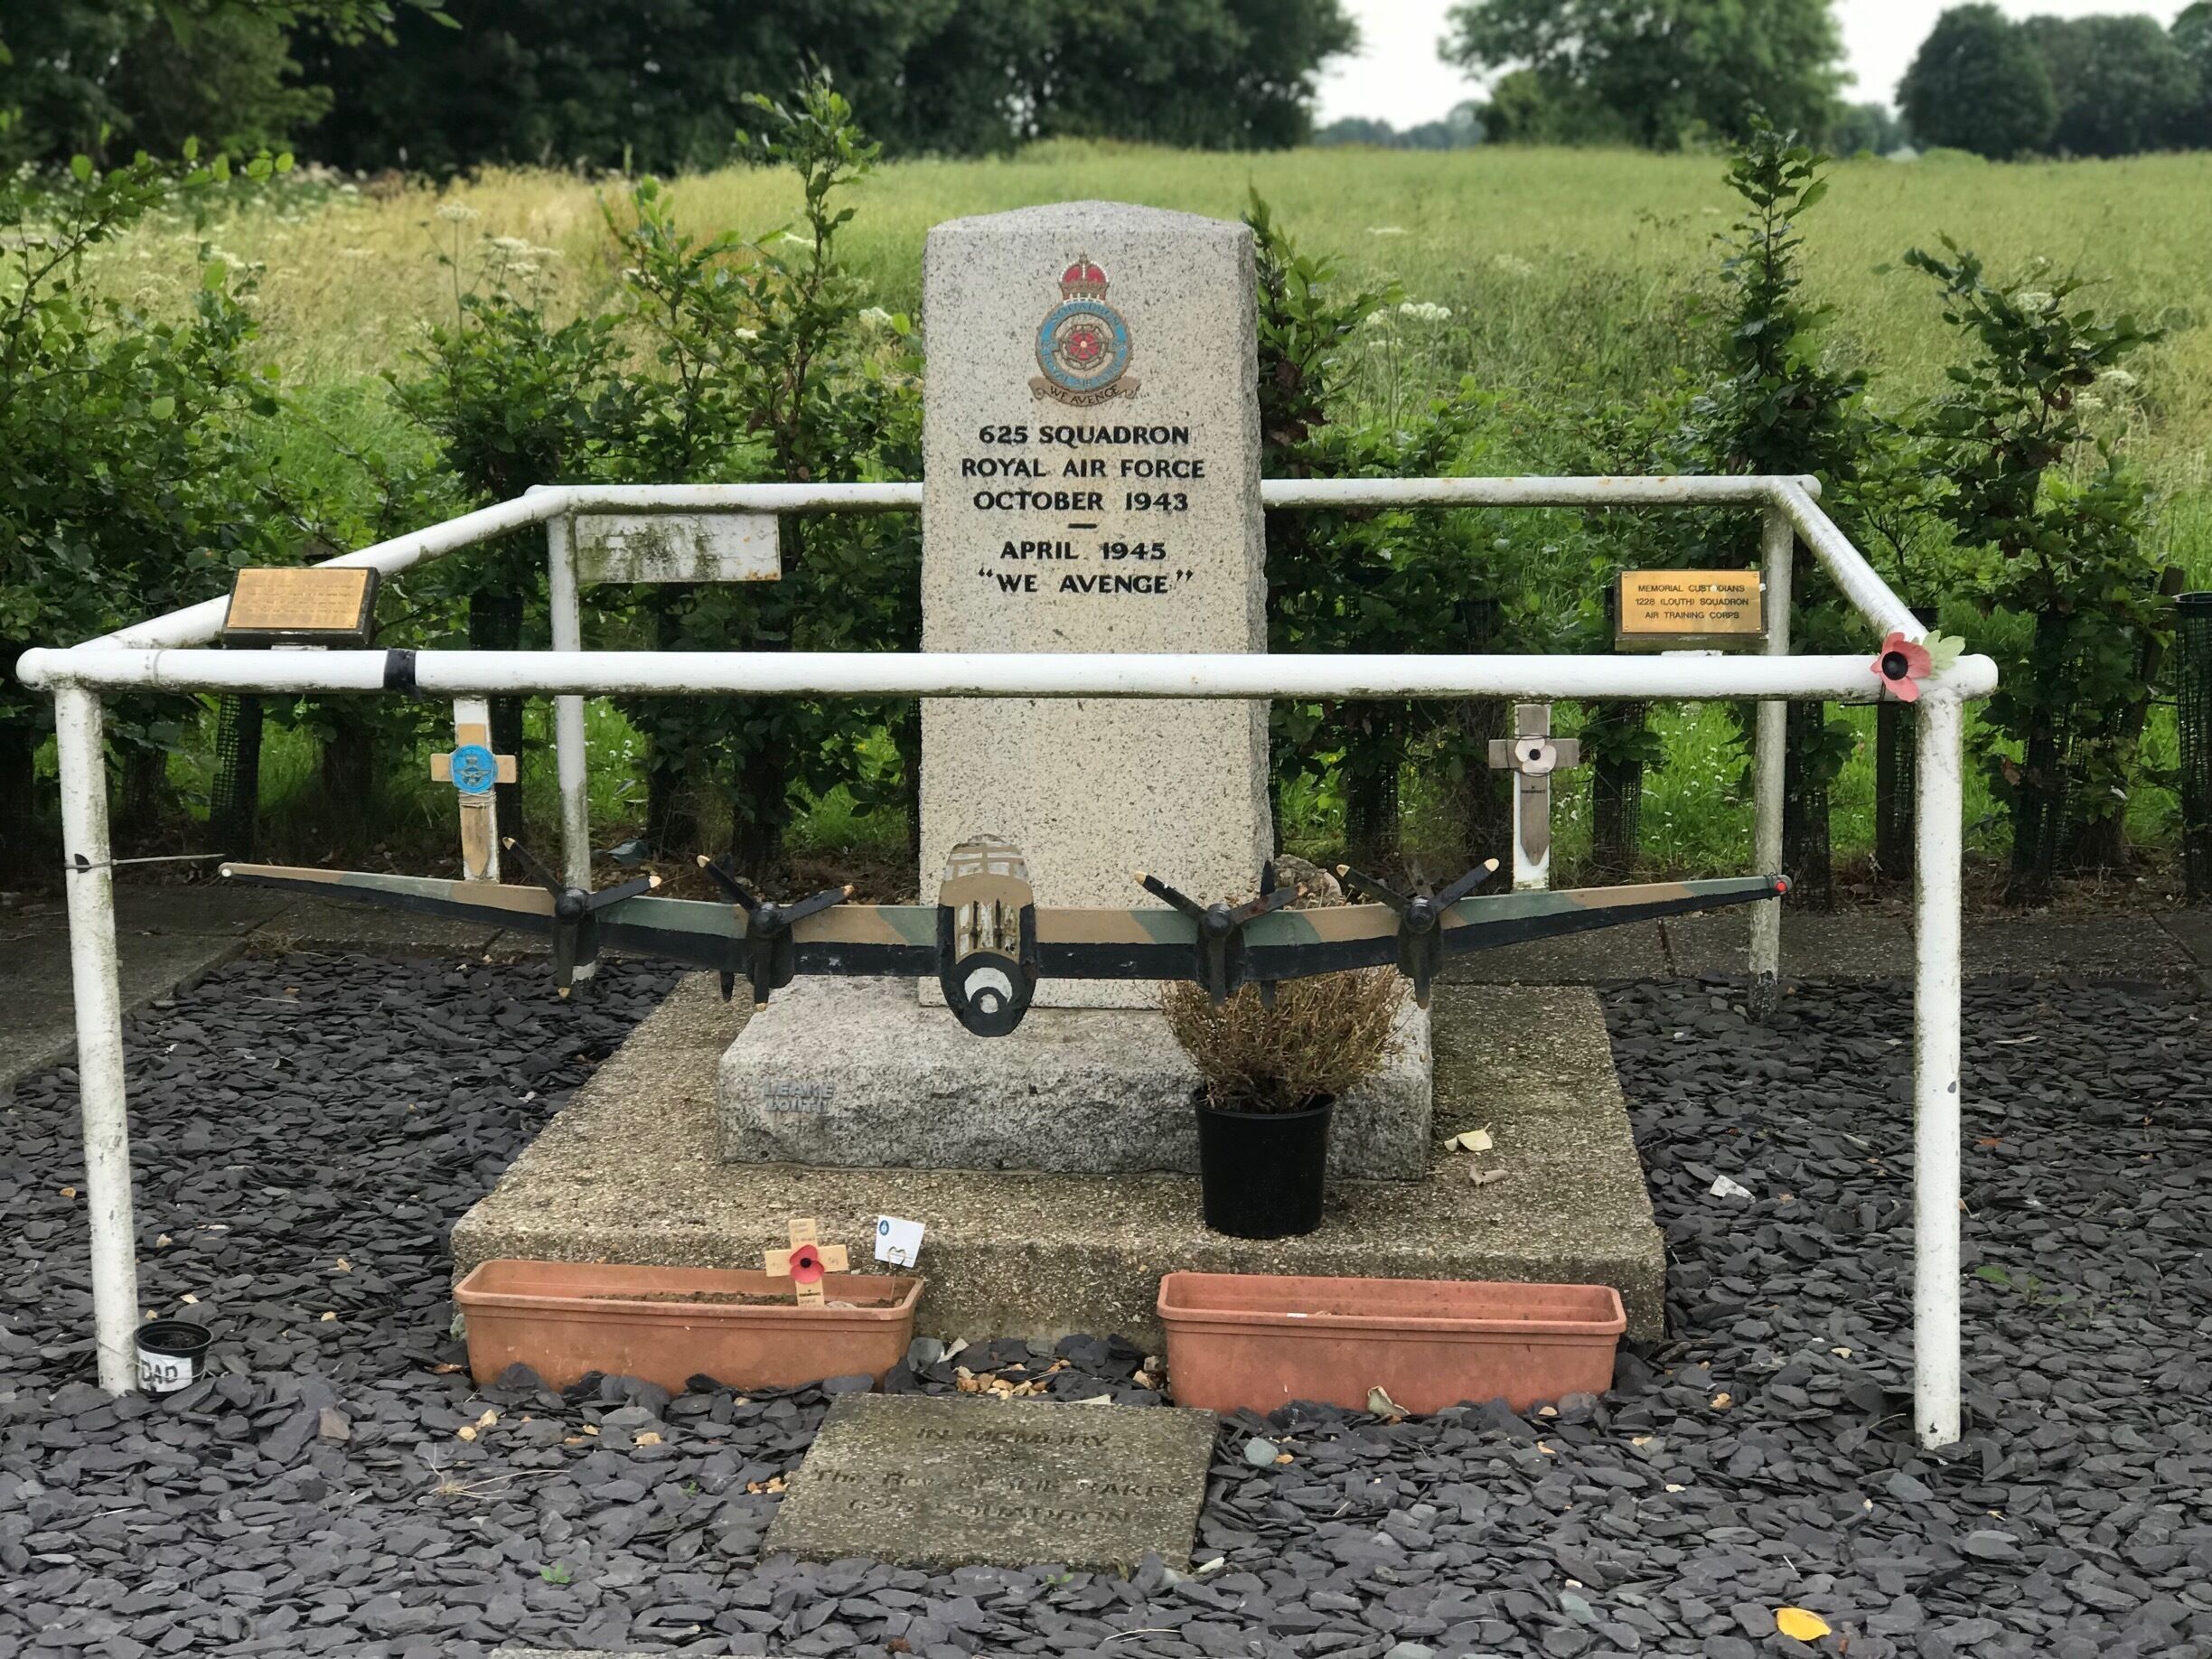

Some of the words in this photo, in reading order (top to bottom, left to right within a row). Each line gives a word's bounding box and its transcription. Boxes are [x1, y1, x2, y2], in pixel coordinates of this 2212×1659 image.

[1049, 385, 1067, 400] WE
[1070, 383, 1120, 405] AVENGE
[979, 425, 1028, 445] 625
[1038, 426, 1189, 448] SQUADRON
[961, 458, 1047, 478] ROYAL
[1062, 459, 1106, 478] AIR
[1120, 459, 1205, 479] FORCE
[972, 491, 1104, 511] OCTOBER
[1126, 492, 1188, 511] 1943
[999, 542, 1079, 560] APRIL
[1102, 542, 1167, 560] 1945
[1637, 585, 1683, 593] MEMORIAL
[1660, 597, 1695, 606] (LOUTH)
[1700, 598, 1749, 606] SQUADRON
[1664, 612, 1705, 620] TRAINING
[1709, 612, 1740, 620] CORPS
[141, 1359, 178, 1384] DAD
